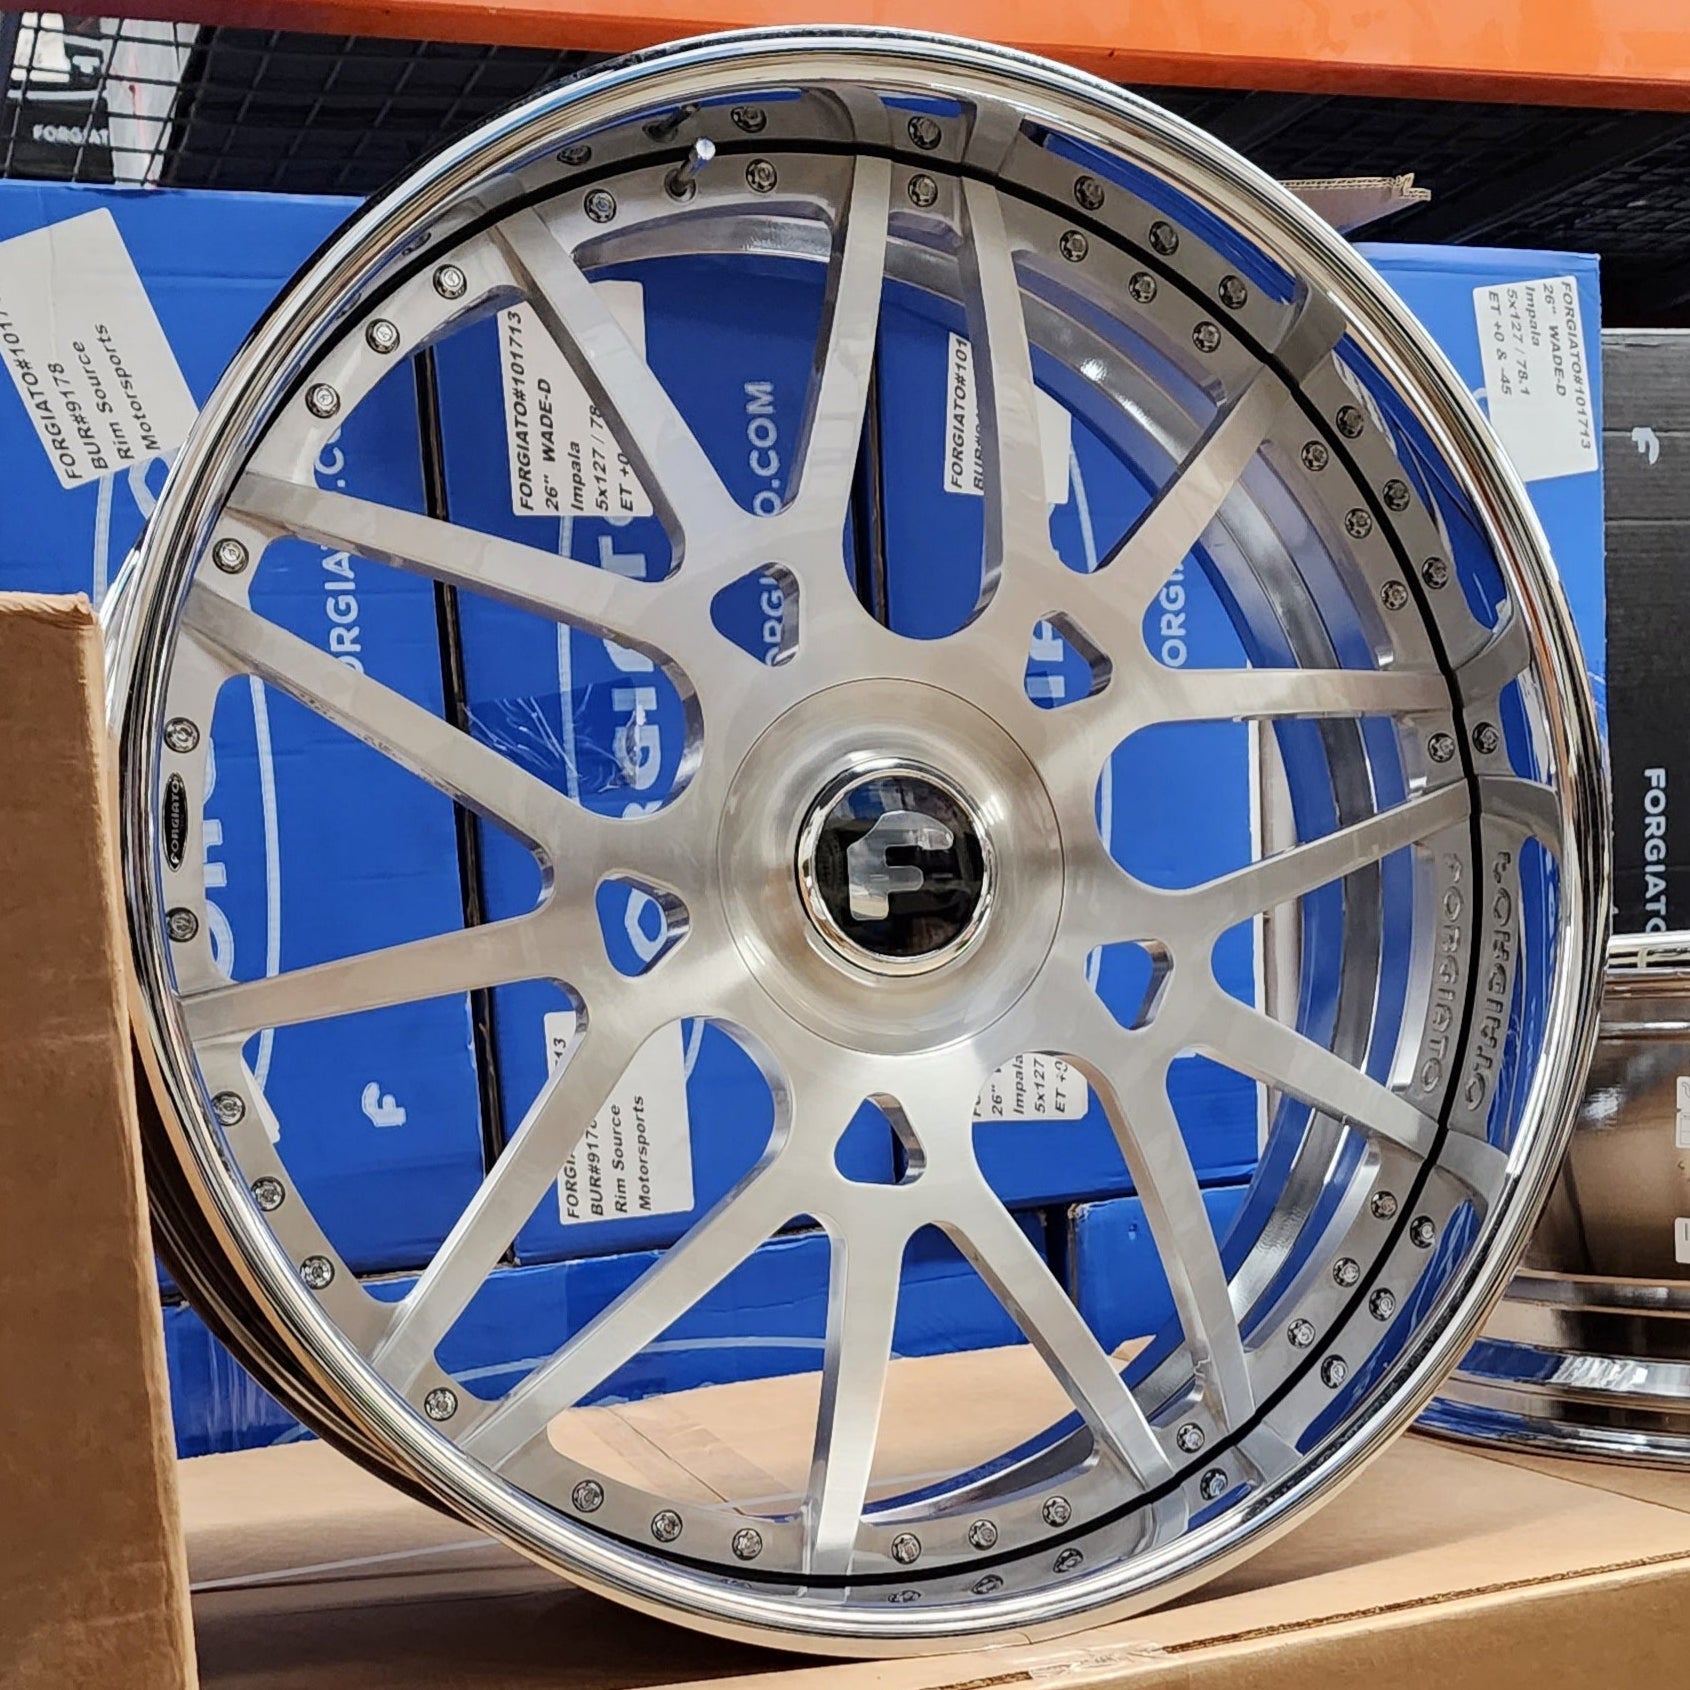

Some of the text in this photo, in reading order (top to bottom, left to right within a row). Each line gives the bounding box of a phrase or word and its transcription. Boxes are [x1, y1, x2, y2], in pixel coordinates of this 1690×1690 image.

[1489, 291, 1501, 315] ET
[1493, 322, 1504, 342] +0
[1507, 288, 1524, 344] 5x127
[1516, 360, 1530, 395] 78.1
[1525, 286, 1541, 347] Impala
[95, 323, 161, 450] Motorsports
[1496, 349, 1507, 361] &
[1549, 325, 1567, 396] WADE-D
[1561, 281, 1591, 449] FORGIATO#101713
[48, 362, 108, 469] BUR#9178
[73, 341, 135, 459] Rim Source
[507, 311, 534, 511] FORGIATO#101713
[951, 338, 968, 489] FORGIATO#101
[538, 378, 560, 511] 26" WADE-D
[568, 441, 586, 511] Impala
[592, 448, 609, 511] 5x127
[617, 452, 634, 511] ET +0
[170, 779, 180, 863] FORGIATO
[1421, 852, 1464, 1093] FORGIATO
[991, 1084, 1003, 1116] 26"
[1033, 1058, 1046, 1113] 5x127
[1055, 1088, 1066, 1113] ET
[611, 1104, 628, 1213] Rim Source
[633, 1096, 652, 1210] Motorsports
